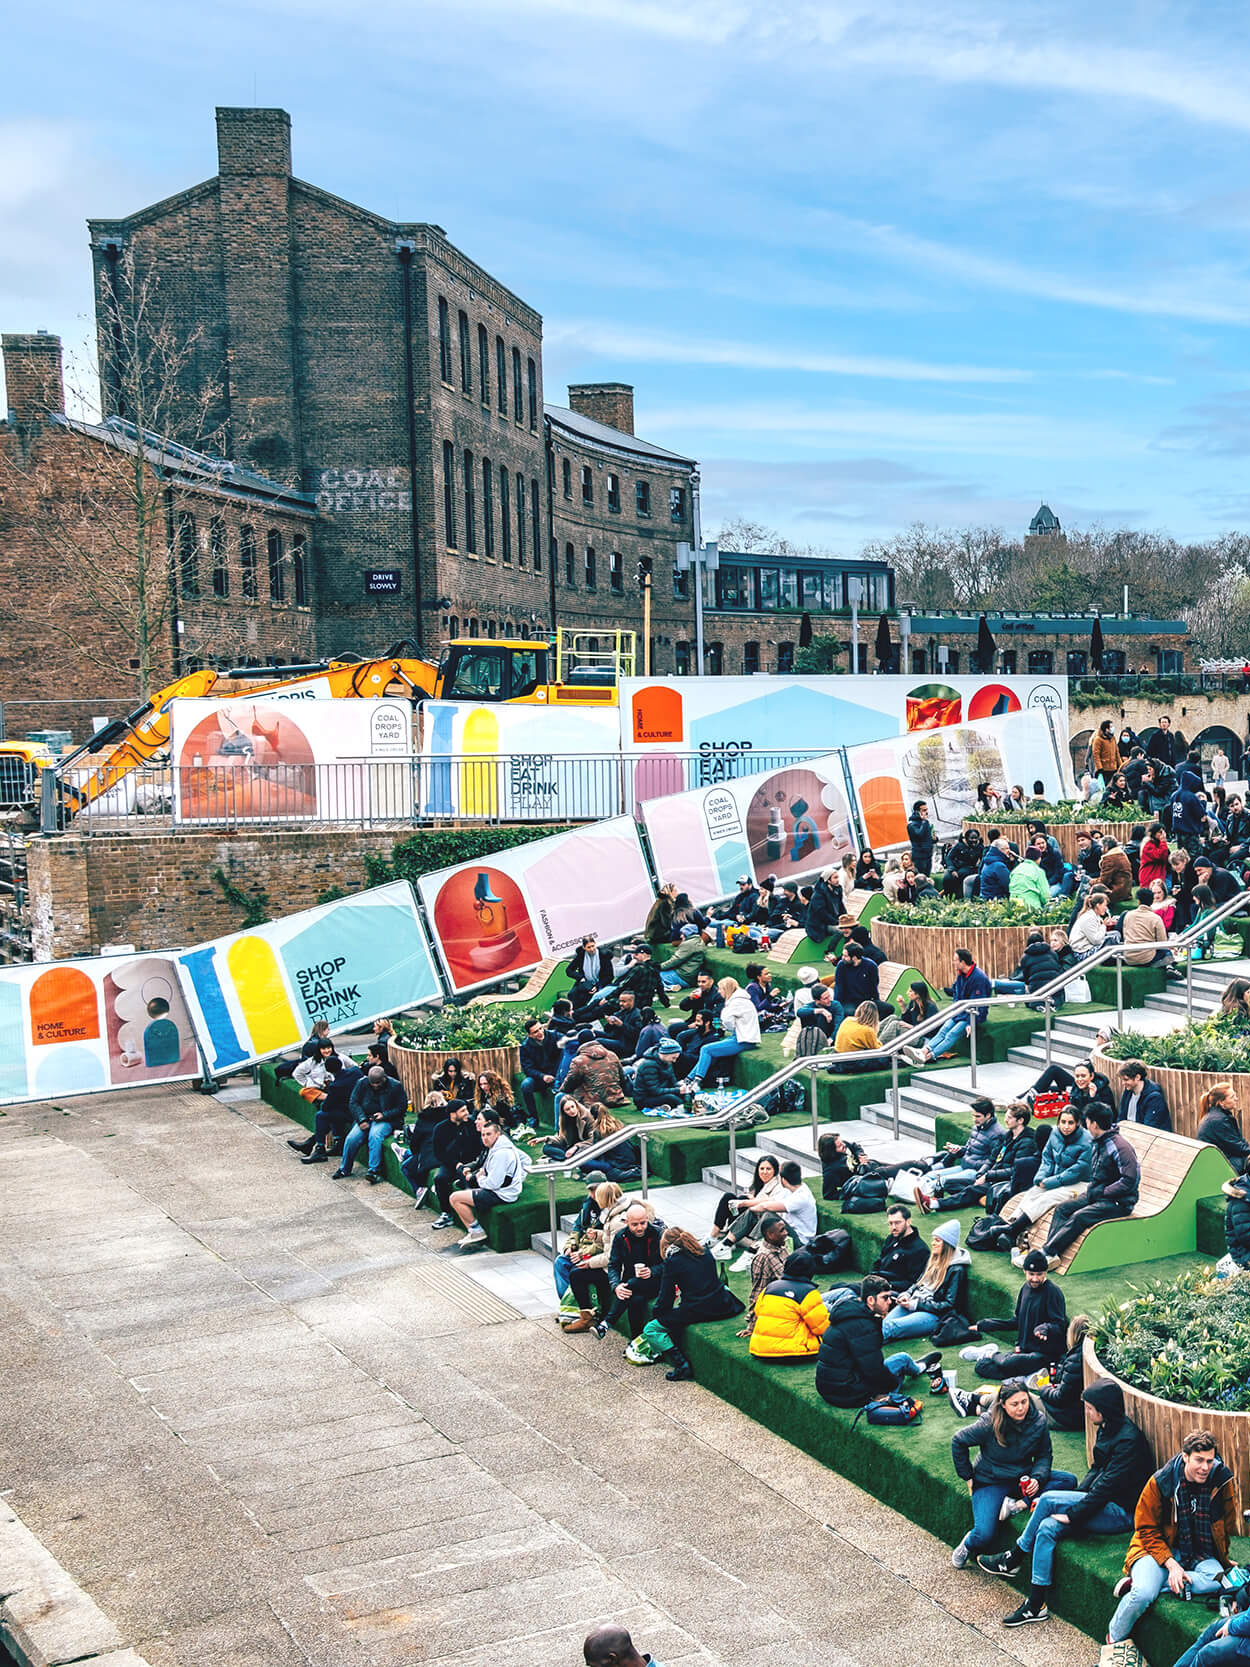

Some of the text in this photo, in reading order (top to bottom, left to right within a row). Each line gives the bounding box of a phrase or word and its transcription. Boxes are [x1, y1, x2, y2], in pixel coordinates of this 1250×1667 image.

[1033, 695, 1054, 703] COAL
[377, 714, 399, 722] COAL
[375, 723, 402, 731] DROPS
[699, 741, 753, 758] SHOP
[510, 753, 553, 767] SHOP
[700, 759, 736, 776] EAT
[510, 768, 540, 781] EAT
[510, 782, 558, 795] DRINK
[510, 796, 552, 809] PLAY
[708, 796, 729, 806] COAL
[708, 803, 733, 815] DROPS
[713, 812, 733, 822] YARD
[540, 909, 554, 939] FASHION
[296, 956, 346, 984] SHOP
[300, 976, 333, 1000] EAT
[305, 984, 361, 1014] DRINK
[309, 1001, 359, 1025] PLAY
[37, 1021, 65, 1031] HOME
[46, 1027, 87, 1038] CULTURE
